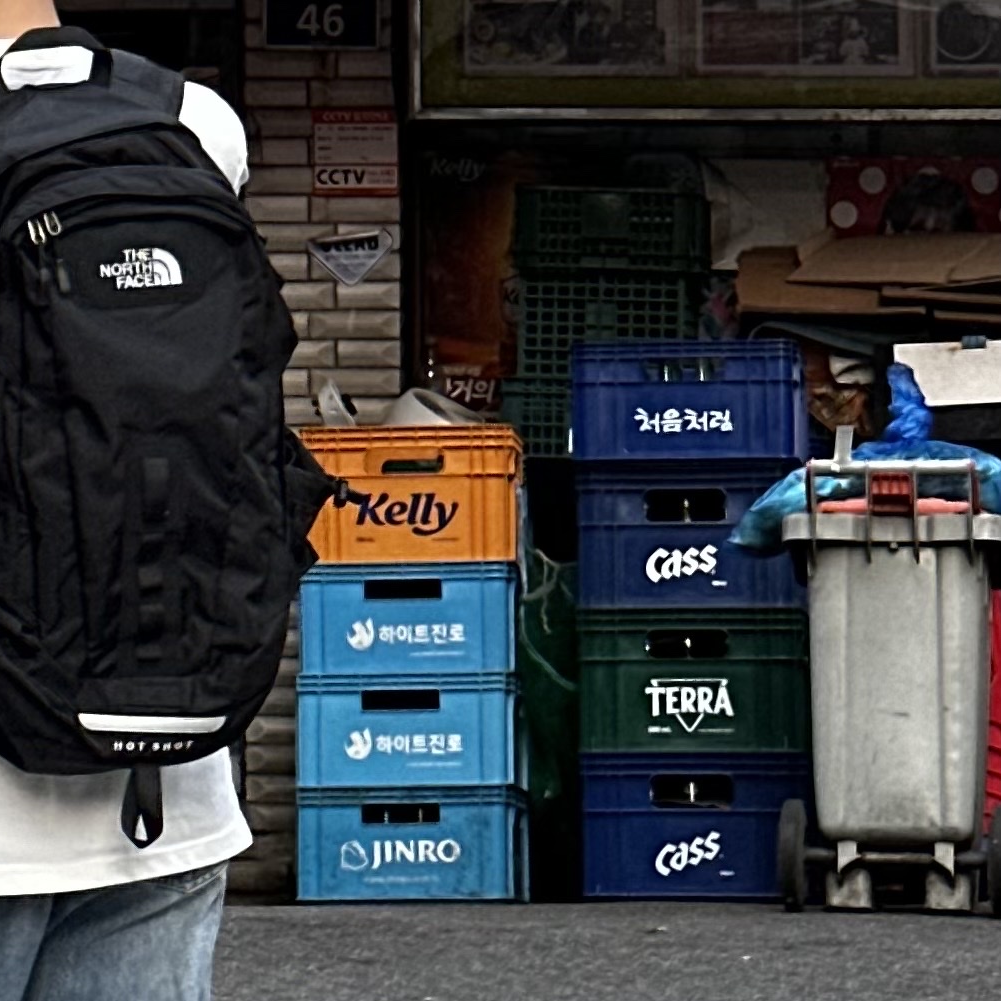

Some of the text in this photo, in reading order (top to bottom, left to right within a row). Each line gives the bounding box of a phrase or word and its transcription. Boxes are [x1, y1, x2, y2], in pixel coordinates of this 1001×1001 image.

[295, 3, 344, 37] 46
[316, 168, 366, 185] CCTV
[429, 157, 486, 182] Kelly
[122, 248, 152, 263] THE
[99, 261, 153, 278] NORTH
[115, 274, 155, 290] FACE
[356, 492, 459, 536] Kelly
[645, 543, 719, 583] Cass
[379, 623, 466, 644] 하이트진로
[645, 685, 735, 717] TERRA
[113, 739, 194, 752] HOT SHOT
[375, 733, 464, 754] 하이트진로
[371, 838, 461, 870] JINRO
[655, 831, 721, 877] Cass
